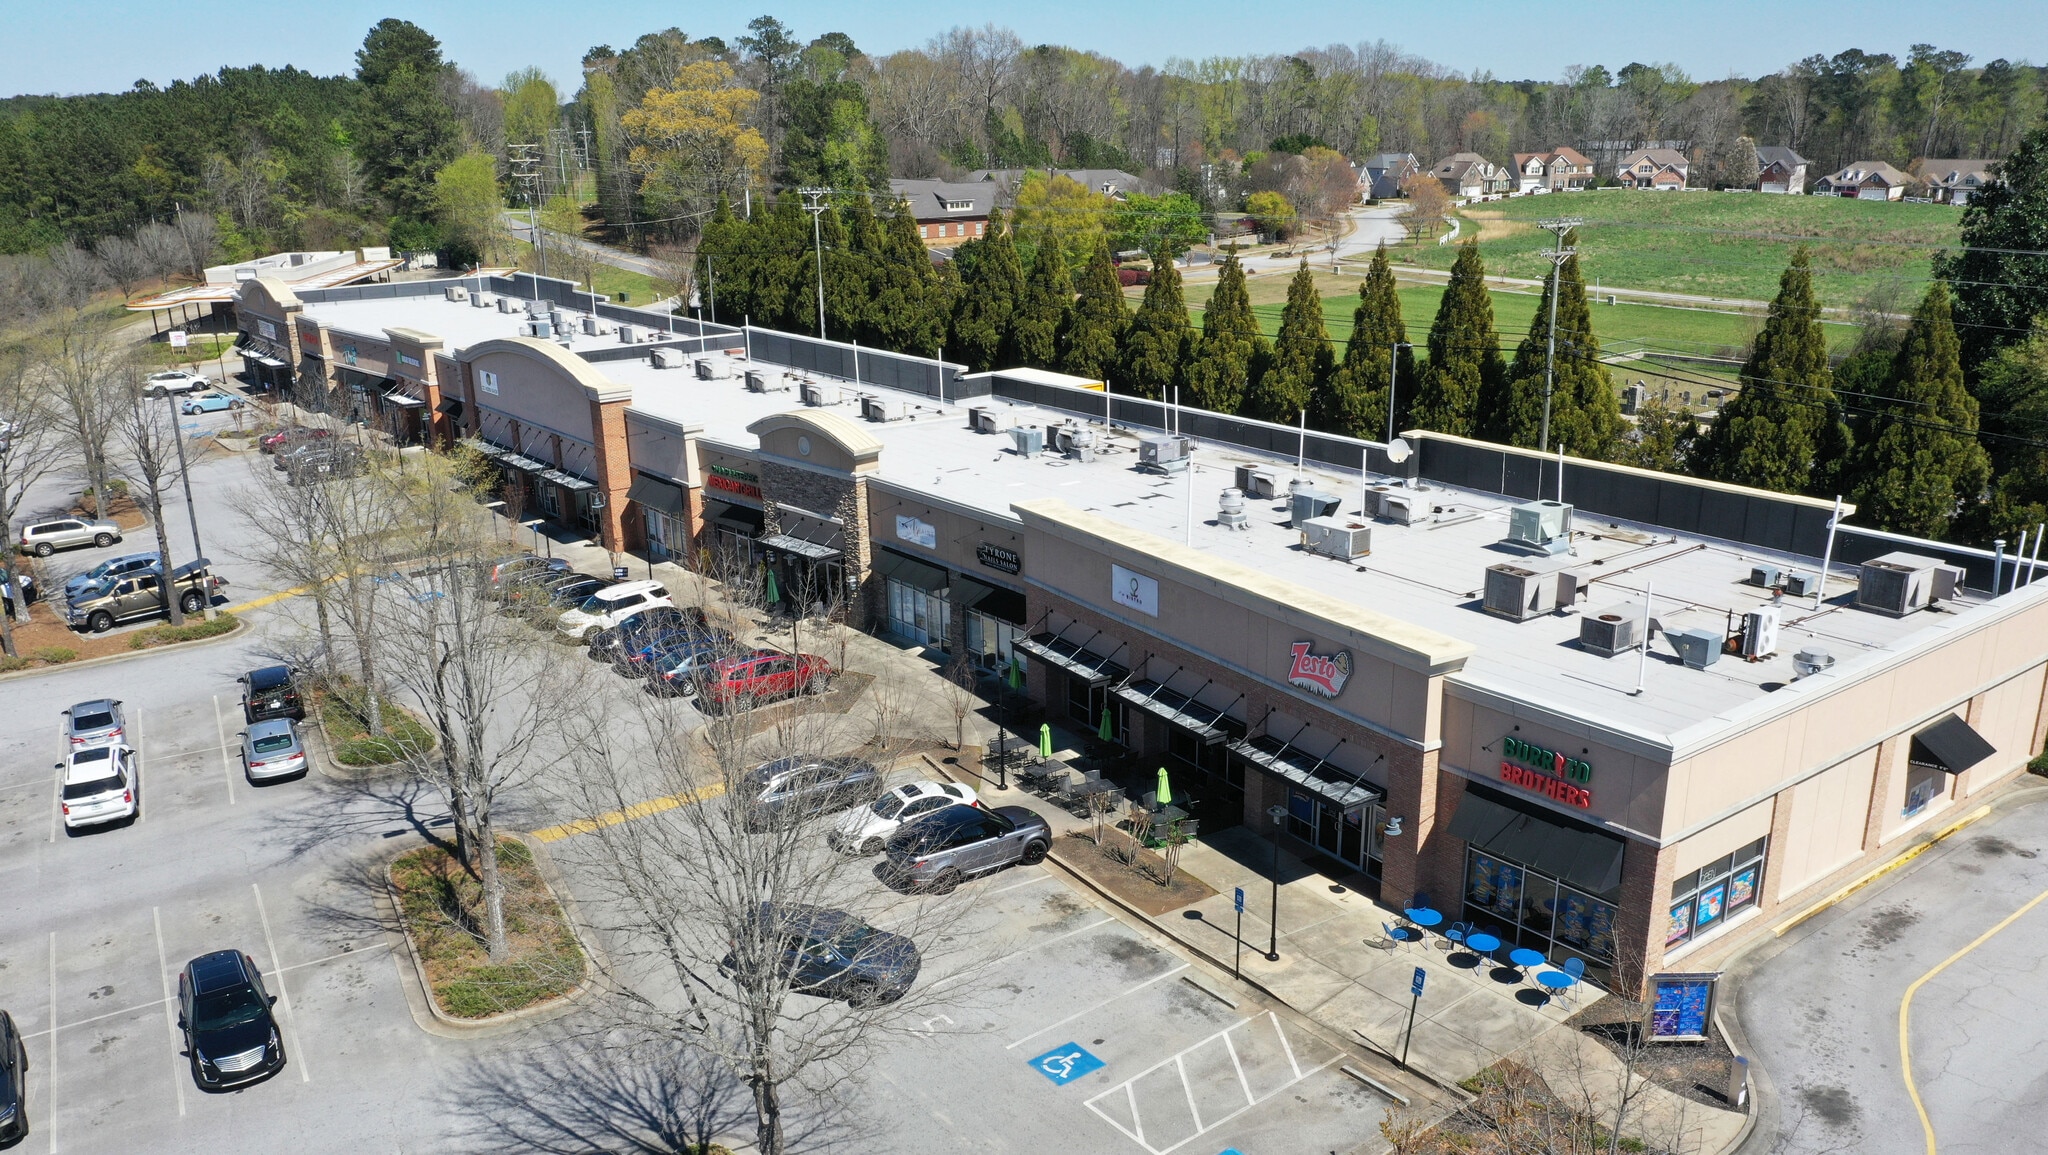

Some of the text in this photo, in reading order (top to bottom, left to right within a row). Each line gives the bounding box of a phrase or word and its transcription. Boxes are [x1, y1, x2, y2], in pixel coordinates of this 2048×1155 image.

[708, 474, 764, 501] MEXICAN GRILL
[984, 545, 1017, 563] TYRONE
[1000, 559, 1018, 571] SALON
[1289, 642, 1338, 693] Zesto
[1503, 736, 1591, 784] BURRITO
[1909, 759, 1938, 768] CLEARANCE
[1501, 760, 1590, 809] BROTHERS
